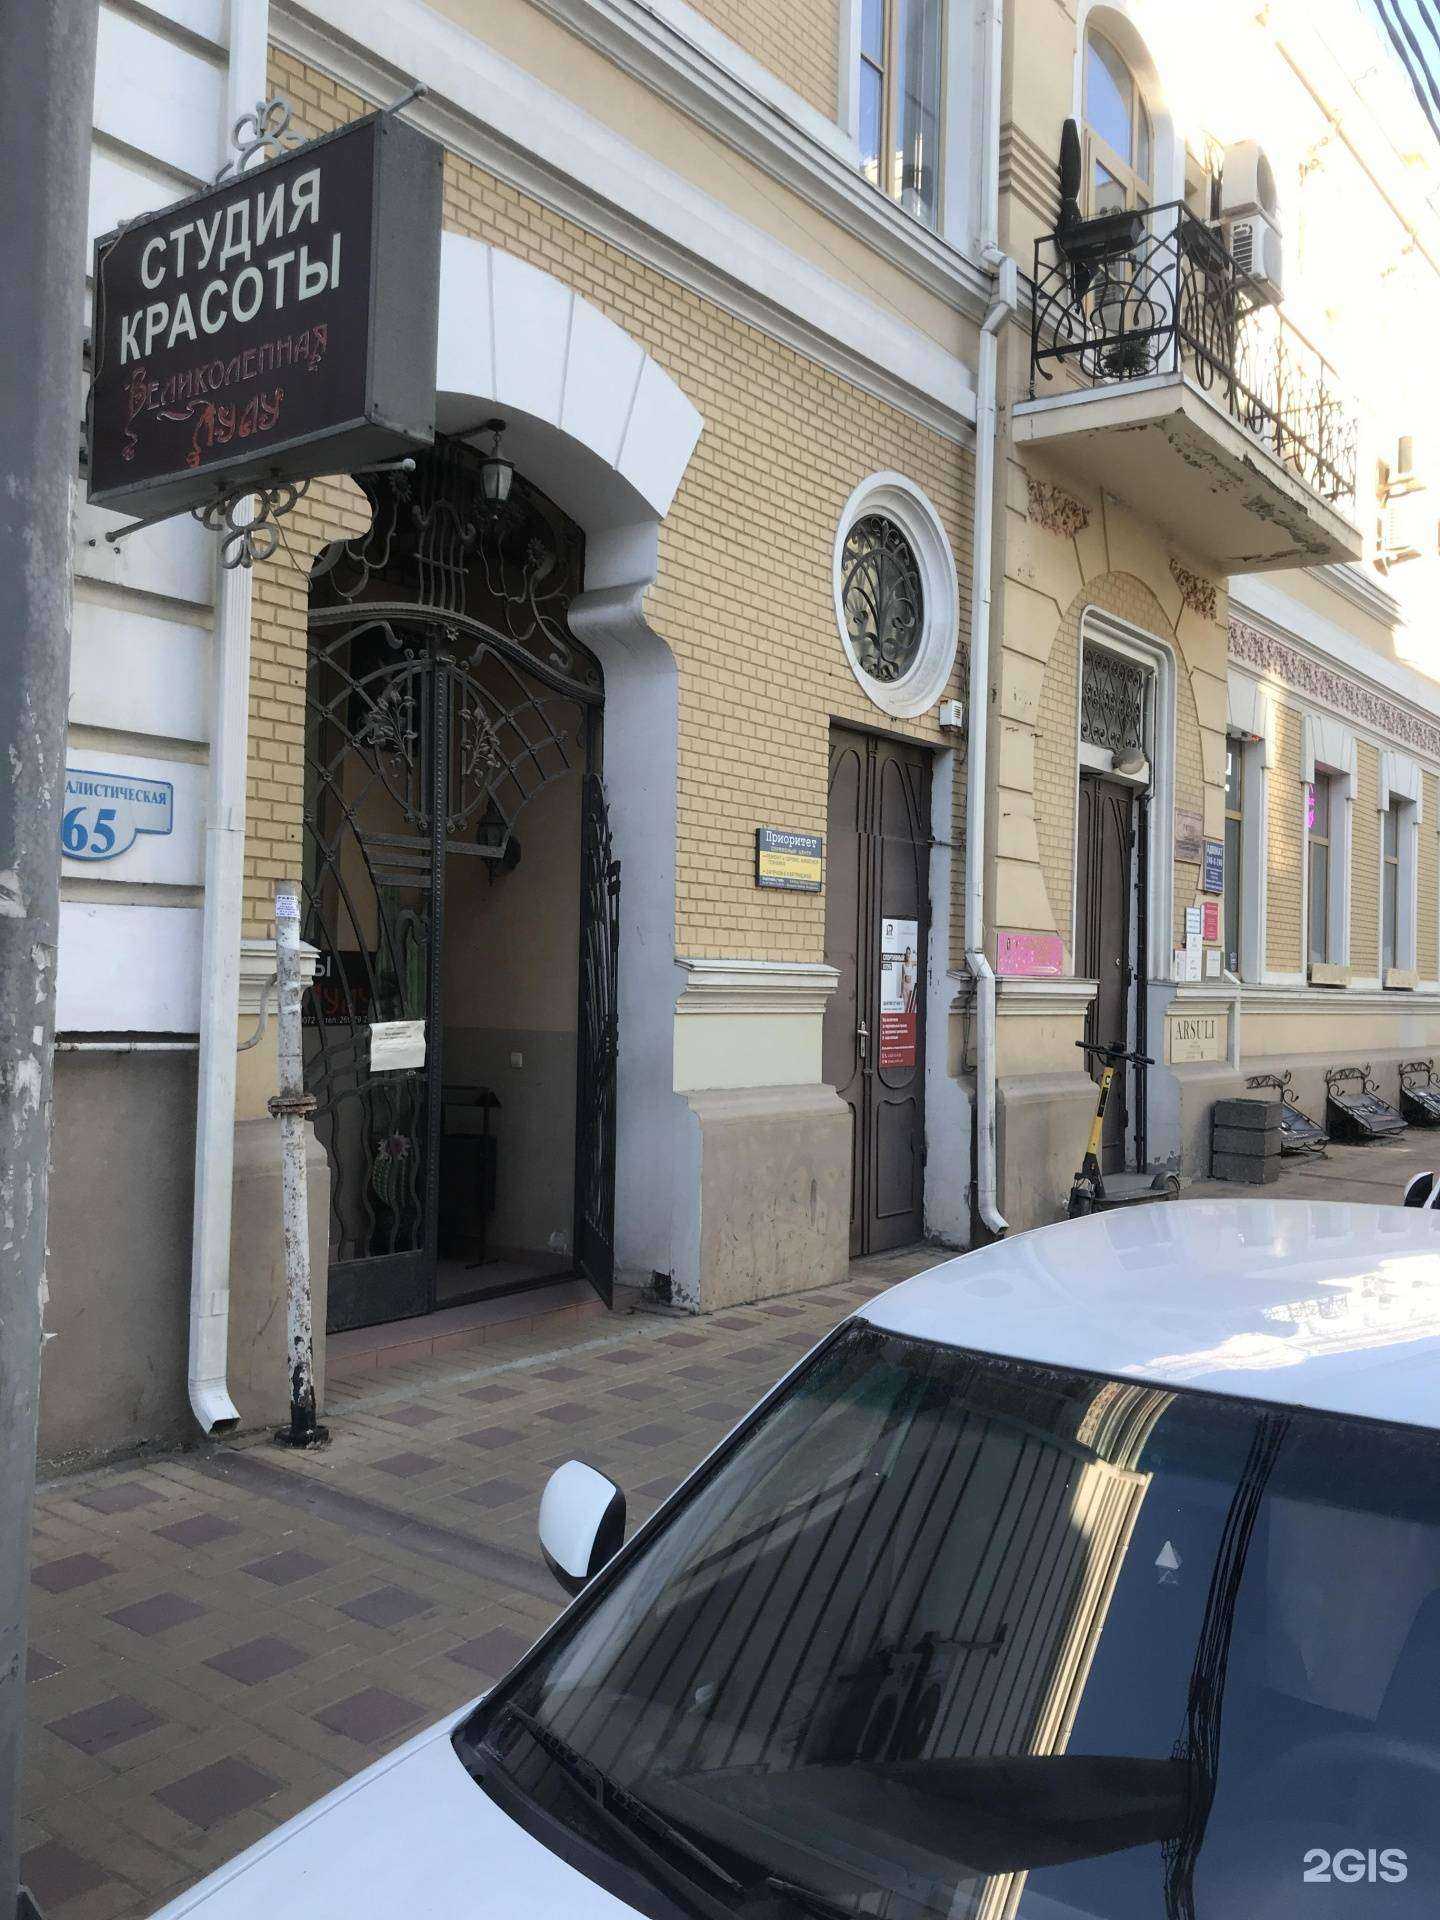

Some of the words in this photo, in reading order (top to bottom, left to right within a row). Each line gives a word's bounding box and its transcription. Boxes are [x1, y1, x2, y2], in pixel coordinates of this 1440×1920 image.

[140, 168, 321, 290] СТУДИЯ
[120, 233, 341, 365] КРАСОТЫ
[62, 806, 116, 854] 65
[766, 830, 817, 848] Приоритет
